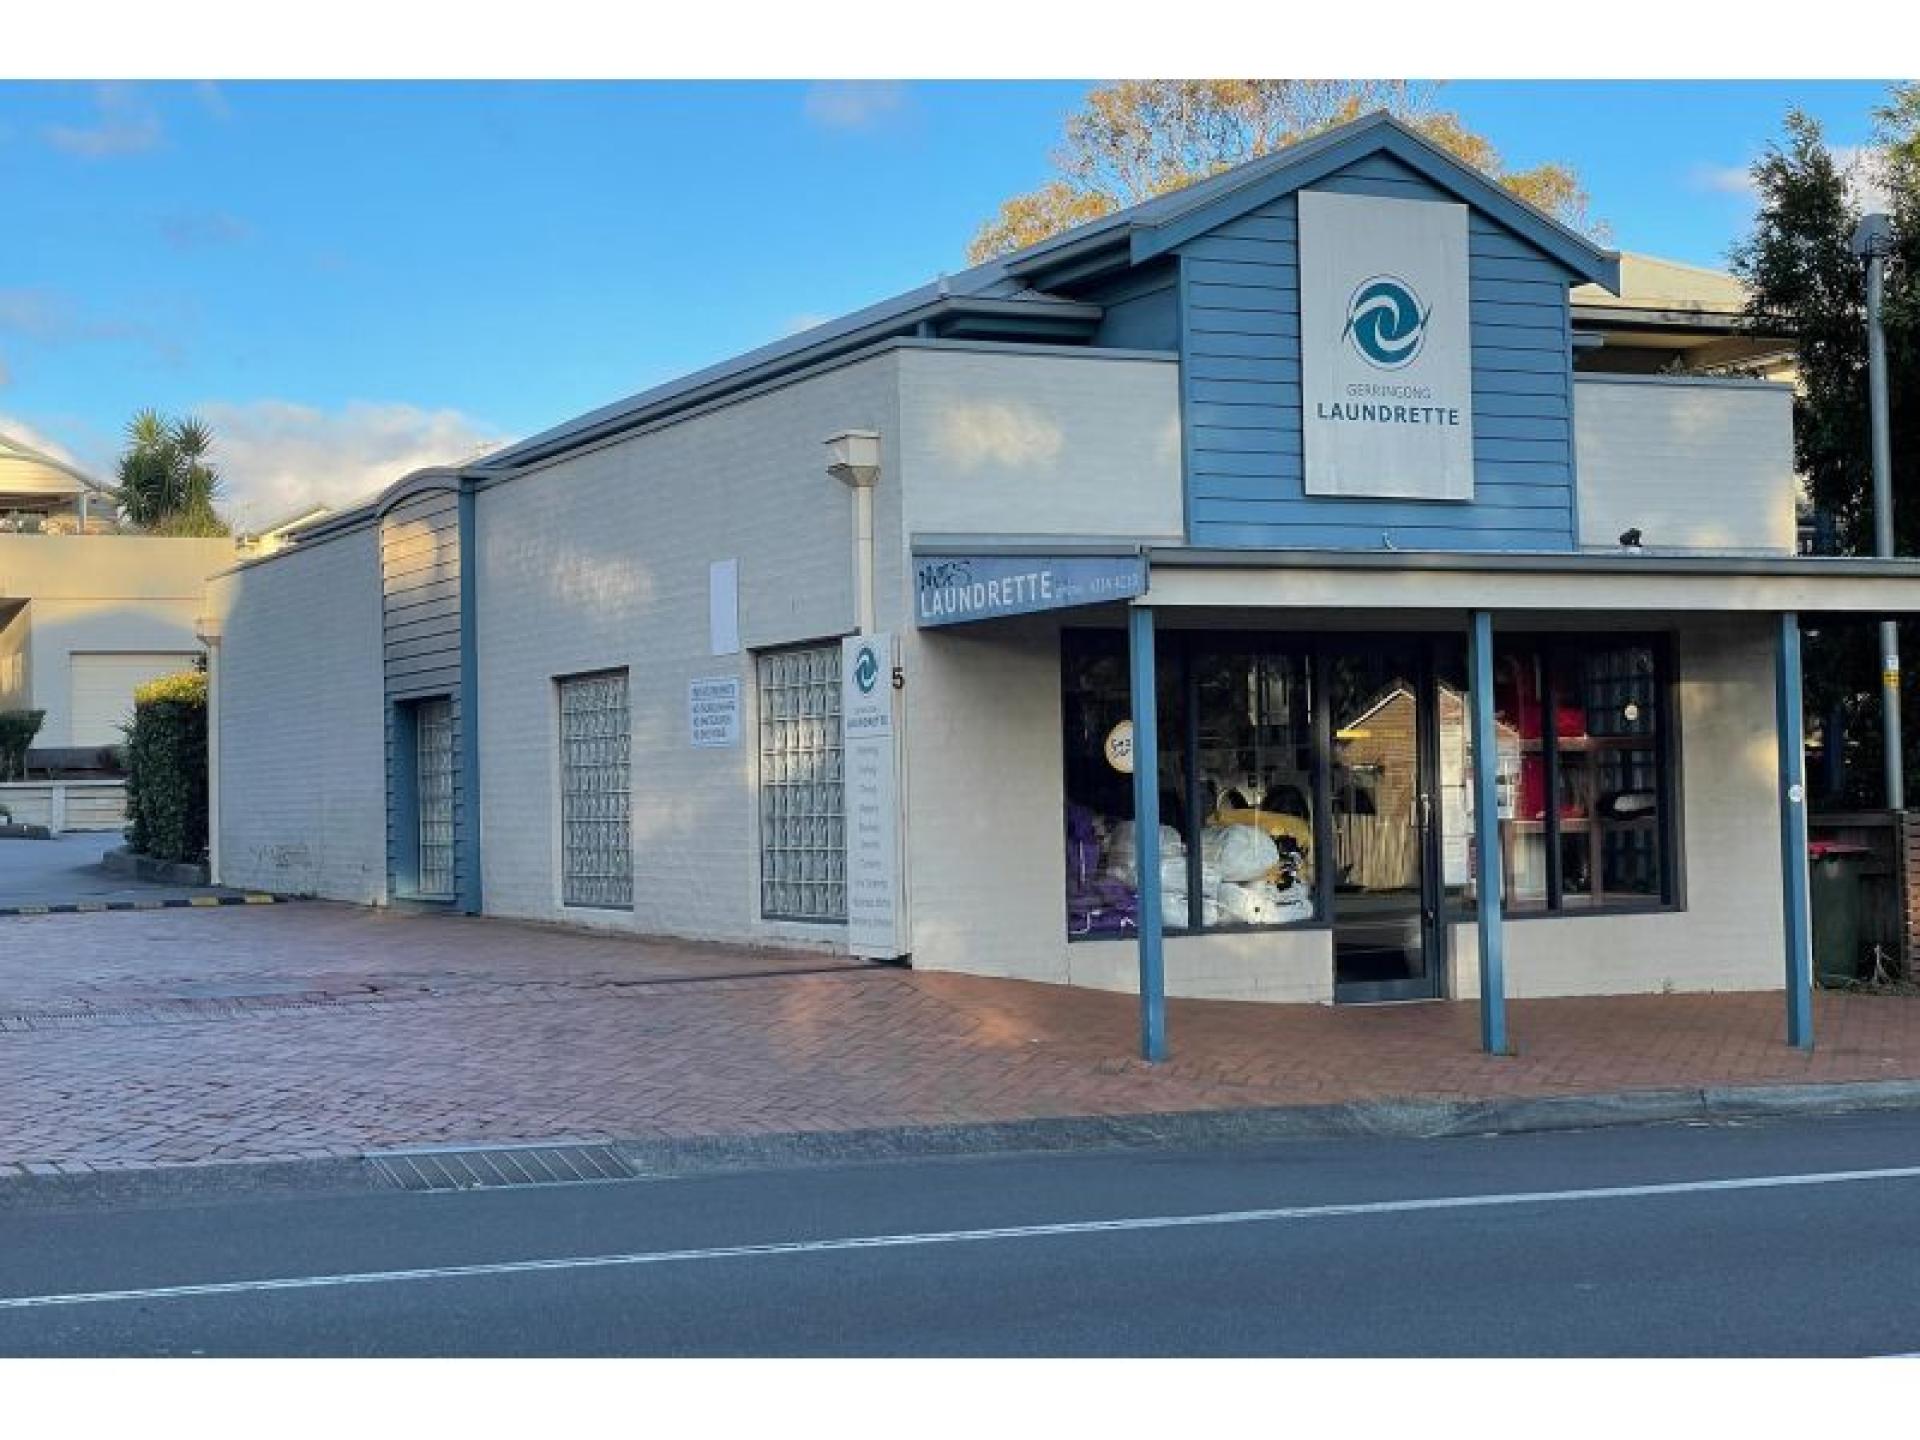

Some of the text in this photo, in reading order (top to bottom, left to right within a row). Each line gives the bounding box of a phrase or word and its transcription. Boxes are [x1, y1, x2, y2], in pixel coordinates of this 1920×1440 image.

[1346, 383, 1432, 399] GERRINGONG
[1317, 402, 1460, 426] LAUNDRETTE
[920, 571, 1052, 618] LAUNDRETTE
[892, 666, 906, 690] 5
